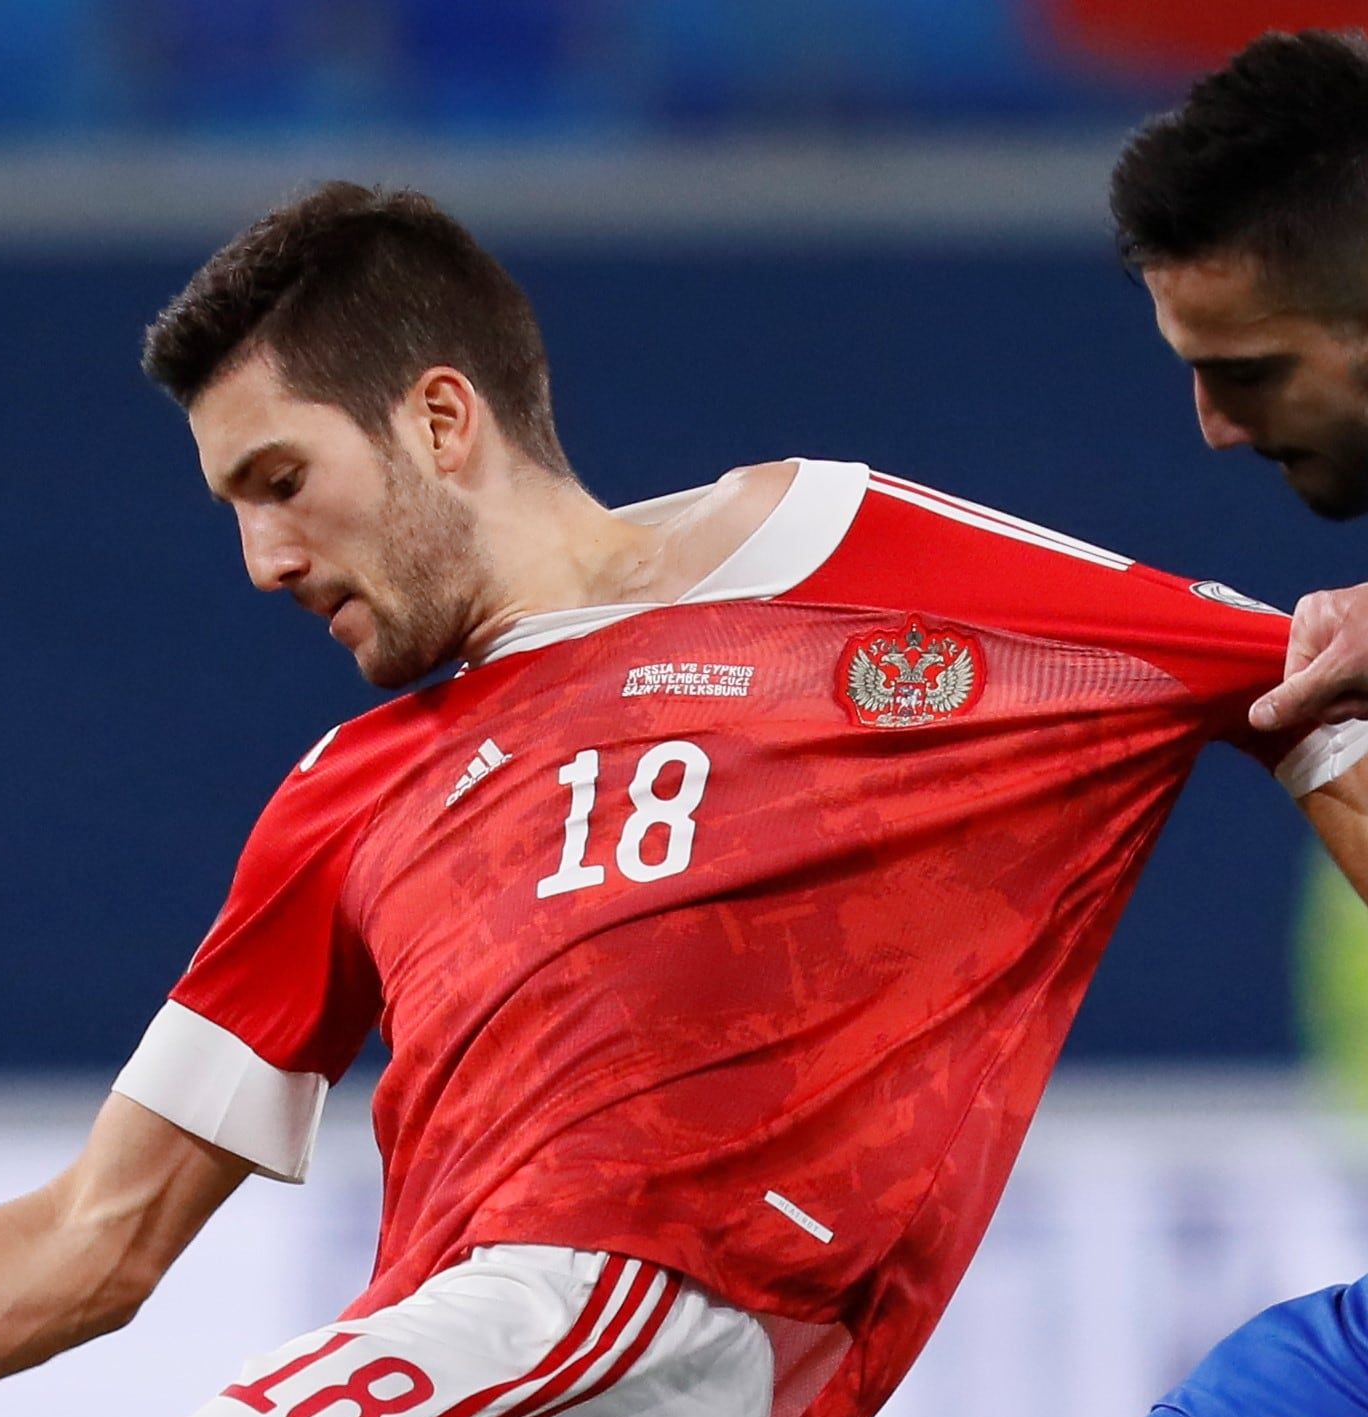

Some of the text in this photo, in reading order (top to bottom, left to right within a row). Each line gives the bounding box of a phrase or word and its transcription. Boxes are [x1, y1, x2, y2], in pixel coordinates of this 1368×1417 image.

[628, 662, 755, 680] RUSSIA VS CYPRUS
[644, 672, 710, 686] NOVEMBER
[718, 676, 751, 687] 2021
[621, 683, 662, 697] SAINT
[536, 739, 712, 900] 18
